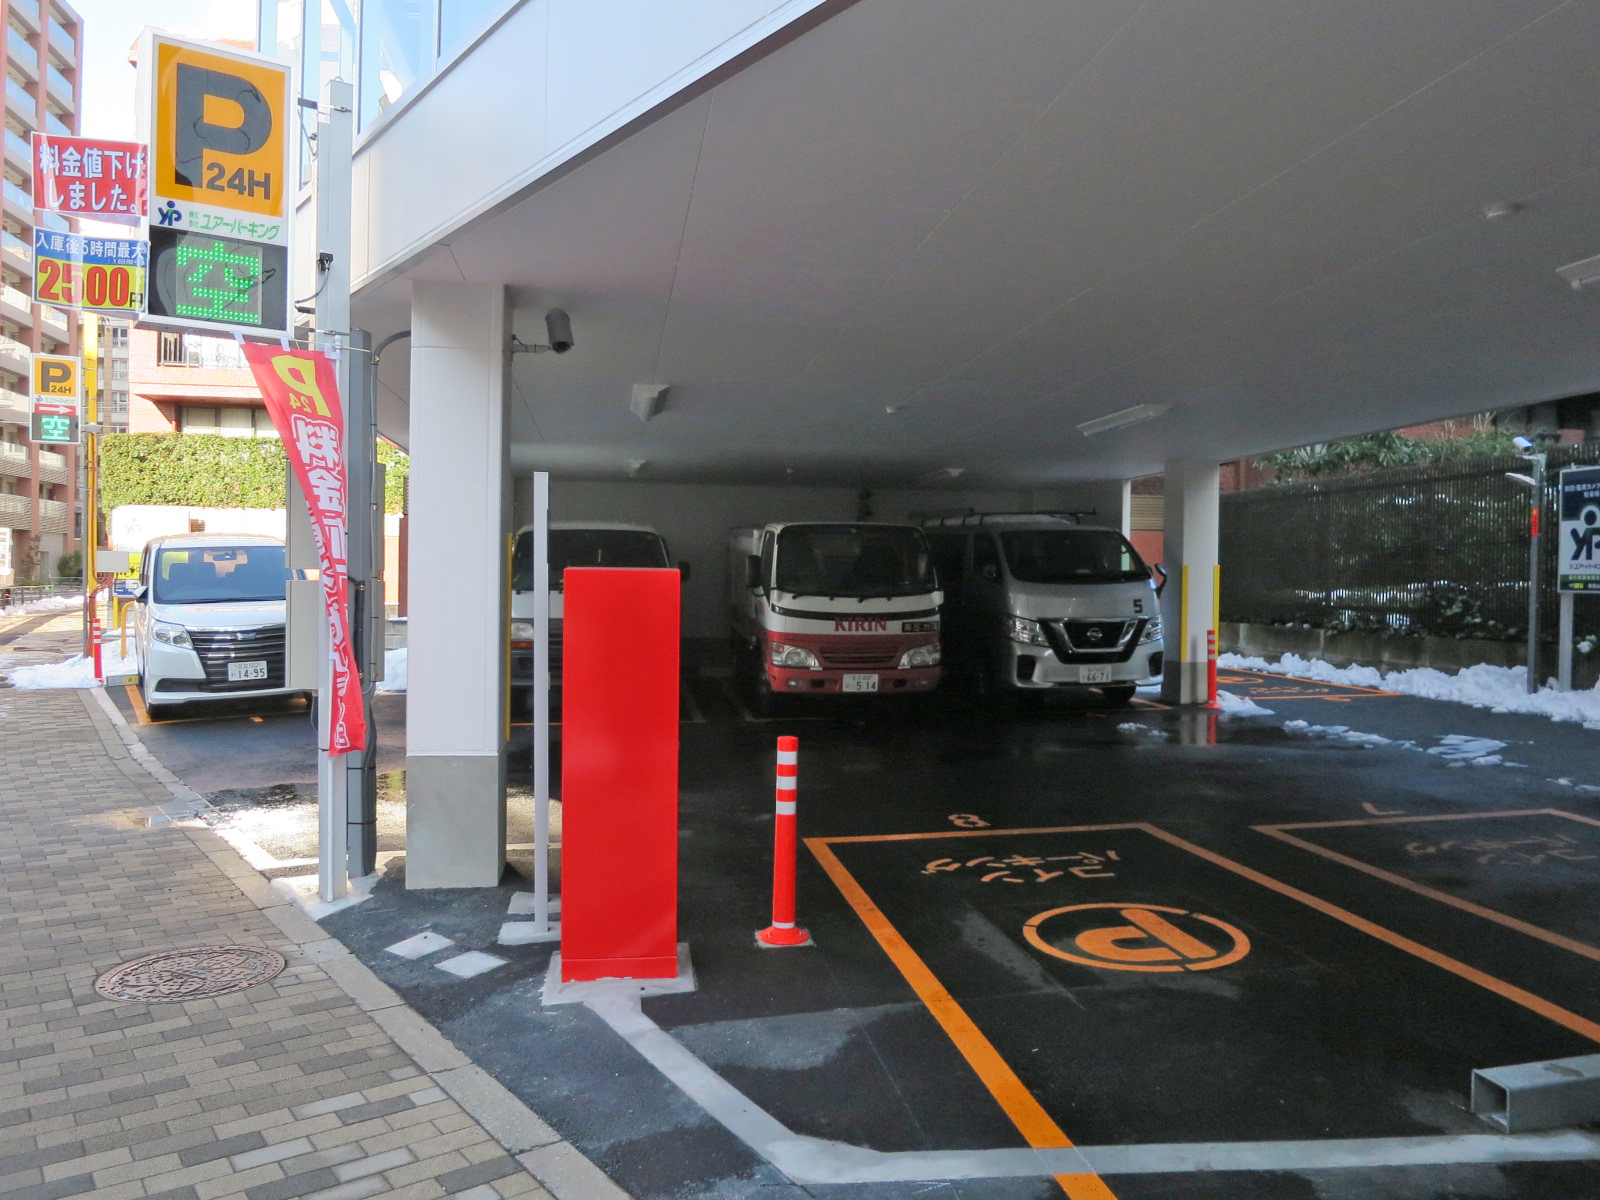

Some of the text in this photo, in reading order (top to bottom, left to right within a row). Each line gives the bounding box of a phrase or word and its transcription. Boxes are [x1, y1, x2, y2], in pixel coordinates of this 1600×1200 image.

[175, 63, 273, 189] P
[39, 143, 145, 181] 料金値下げ
[48, 178, 137, 214] しました。
[206, 162, 271, 200] 24H
[37, 231, 145, 260] 入庫後5時間最大
[176, 241, 260, 324] 空
[41, 361, 72, 393] P
[51, 385, 72, 394] 24H
[41, 415, 71, 441] 空
[1133, 599, 1143, 613] 5
[834, 619, 887, 632] KIRIN
[238, 668, 266, 679] 14-95
